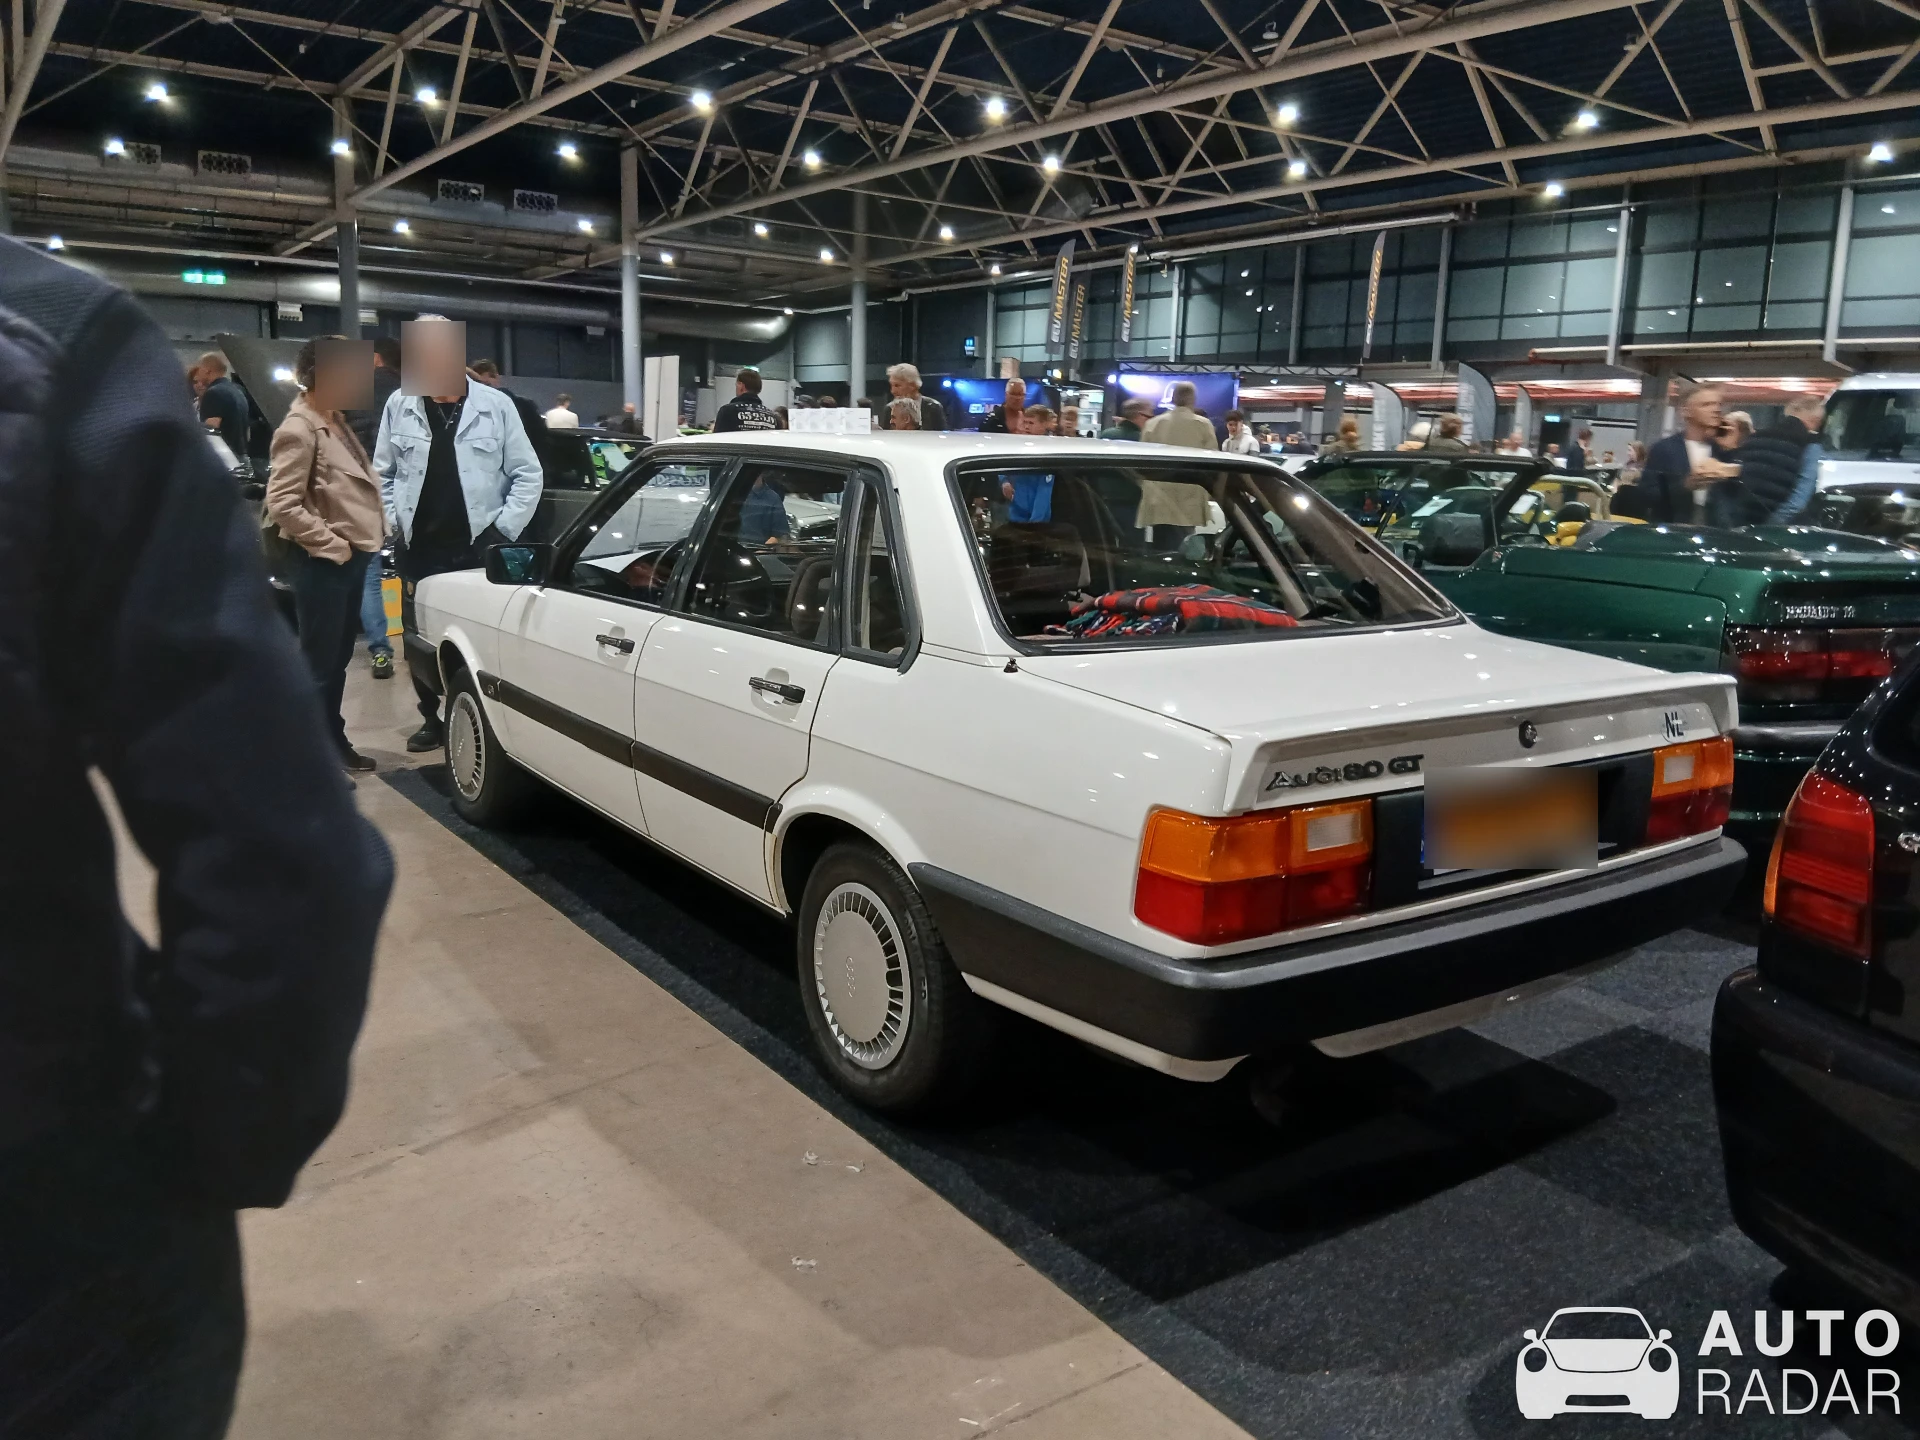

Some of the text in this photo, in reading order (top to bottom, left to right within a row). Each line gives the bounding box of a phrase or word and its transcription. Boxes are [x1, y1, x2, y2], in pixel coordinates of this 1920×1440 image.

[1050, 256, 1069, 343] ECUMASTER
[1664, 711, 1684, 738] NL
[1388, 754, 1424, 774] GT
